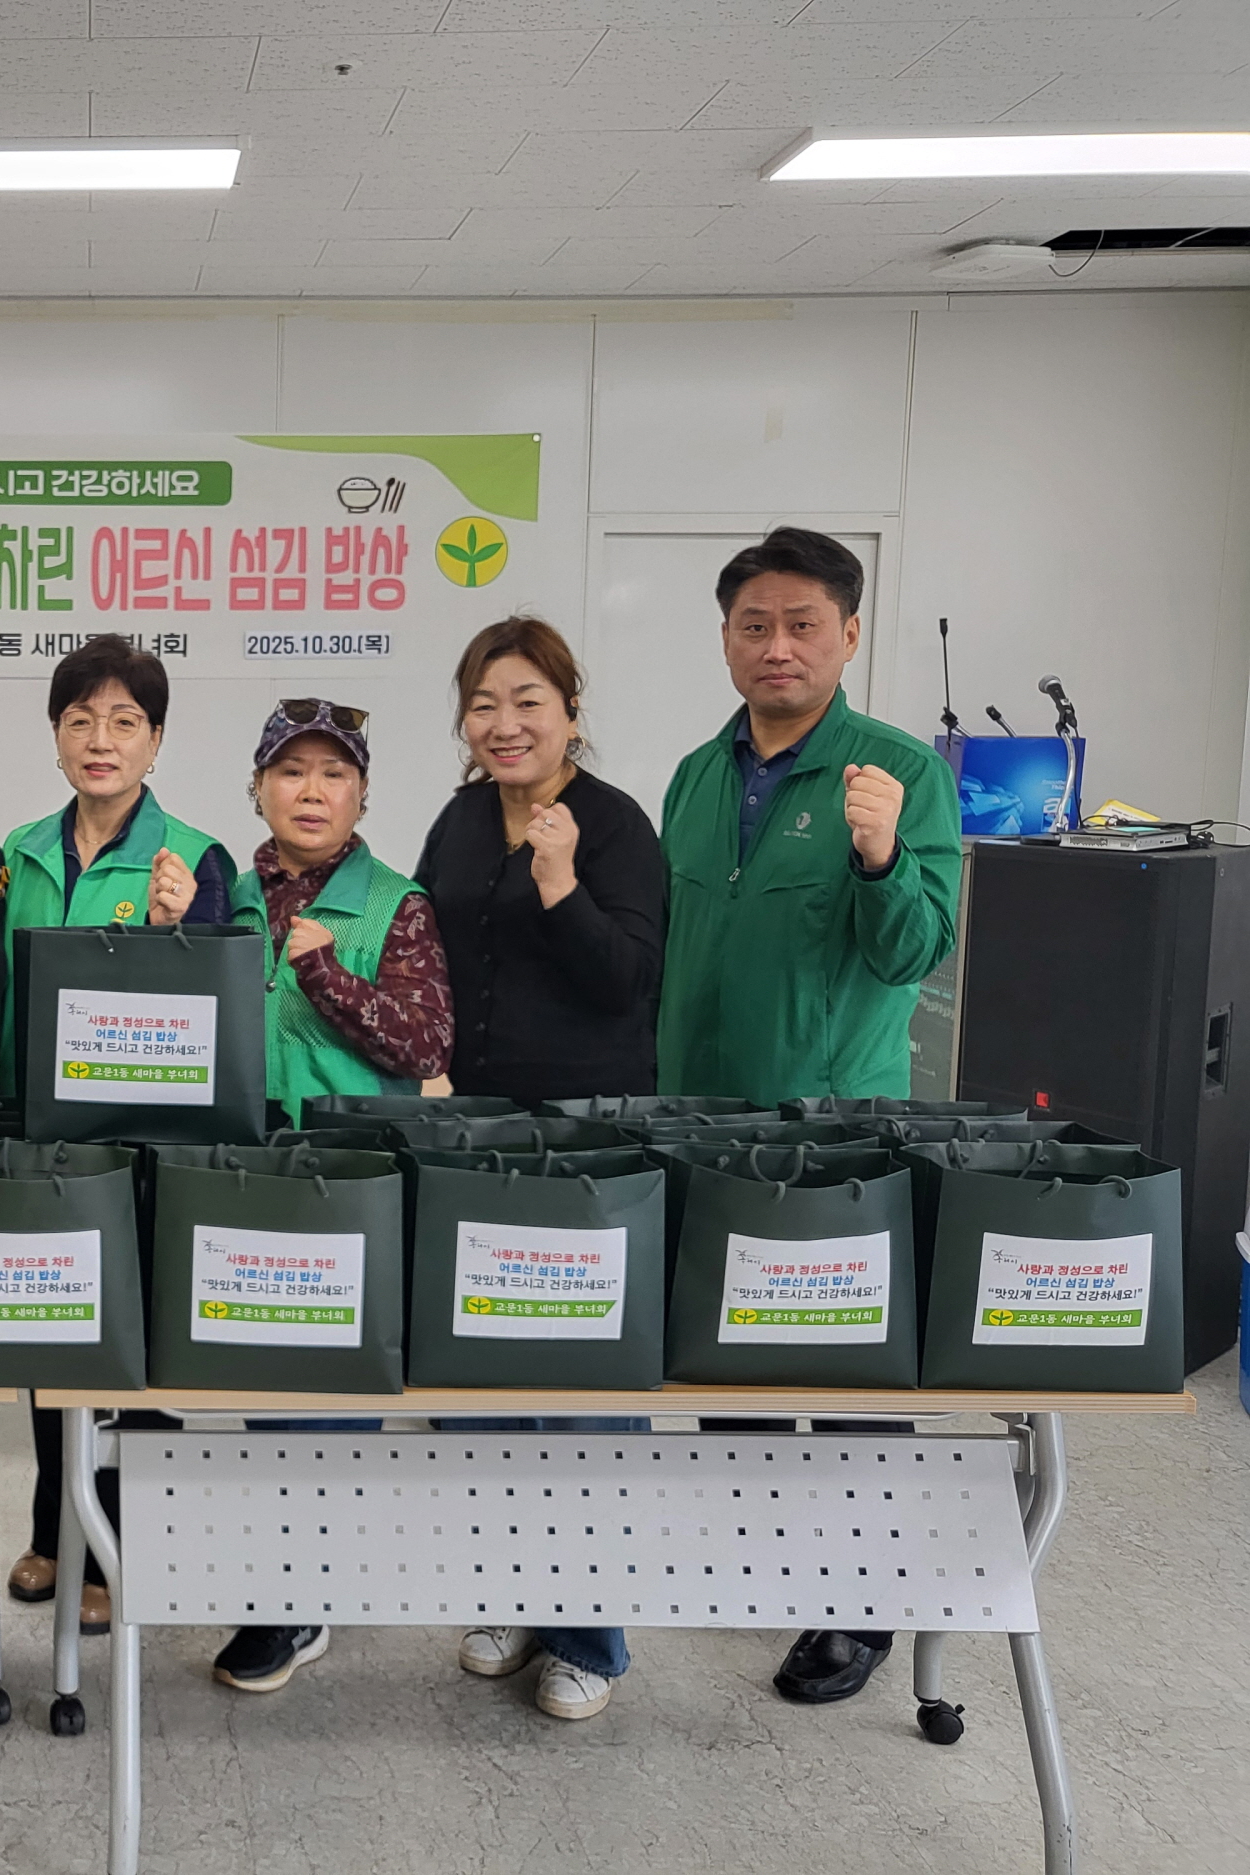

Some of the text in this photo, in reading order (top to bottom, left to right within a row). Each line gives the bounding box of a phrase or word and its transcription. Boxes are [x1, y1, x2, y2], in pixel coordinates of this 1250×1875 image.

[51, 470, 200, 497] 건강하세요
[90, 525, 212, 612] 어르신
[228, 525, 306, 611] 섬김
[323, 524, 408, 611] 밥상
[31, 632, 102, 657] 새마
[87, 1015, 189, 1029] 사랑과 정성으로 차린
[96, 1029, 177, 1042] 어르신 섬김 밥상
[107, 1043, 138, 1054] 드시고
[133, 1069, 163, 1079] 새마을
[3, 1257, 47, 1267] 정성으로
[52, 1256, 74, 1266] 차린
[490, 1249, 600, 1263] 사랑과 정성으로 차린
[226, 1255, 335, 1269] 사랑과 정성으로 차린
[499, 1263, 587, 1277] 어르신 섬김 밥상
[760, 1262, 867, 1274] 사랑과 정성으로 차린
[1018, 1263, 1128, 1275] 사랑과 정성으로 차린
[13, 1270, 34, 1280] 섬김
[39, 1270, 61, 1280] 밥상
[235, 1268, 322, 1282] 어르신 섬김 밥상
[510, 1278, 544, 1288] 드시고
[769, 1275, 854, 1287] 어르신 섬김 밥상
[1026, 1277, 1115, 1288] 어르신 섬김 밥상
[246, 1283, 280, 1294] 드시고
[778, 1289, 812, 1299] 드시고
[1035, 1290, 1071, 1300] 드시고
[15, 1307, 47, 1318] 새마을
[274, 1309, 307, 1320] 새마을
[538, 1304, 570, 1314] 새마을
[804, 1312, 836, 1322] 새마을
[1061, 1313, 1095, 1323] 새마을
